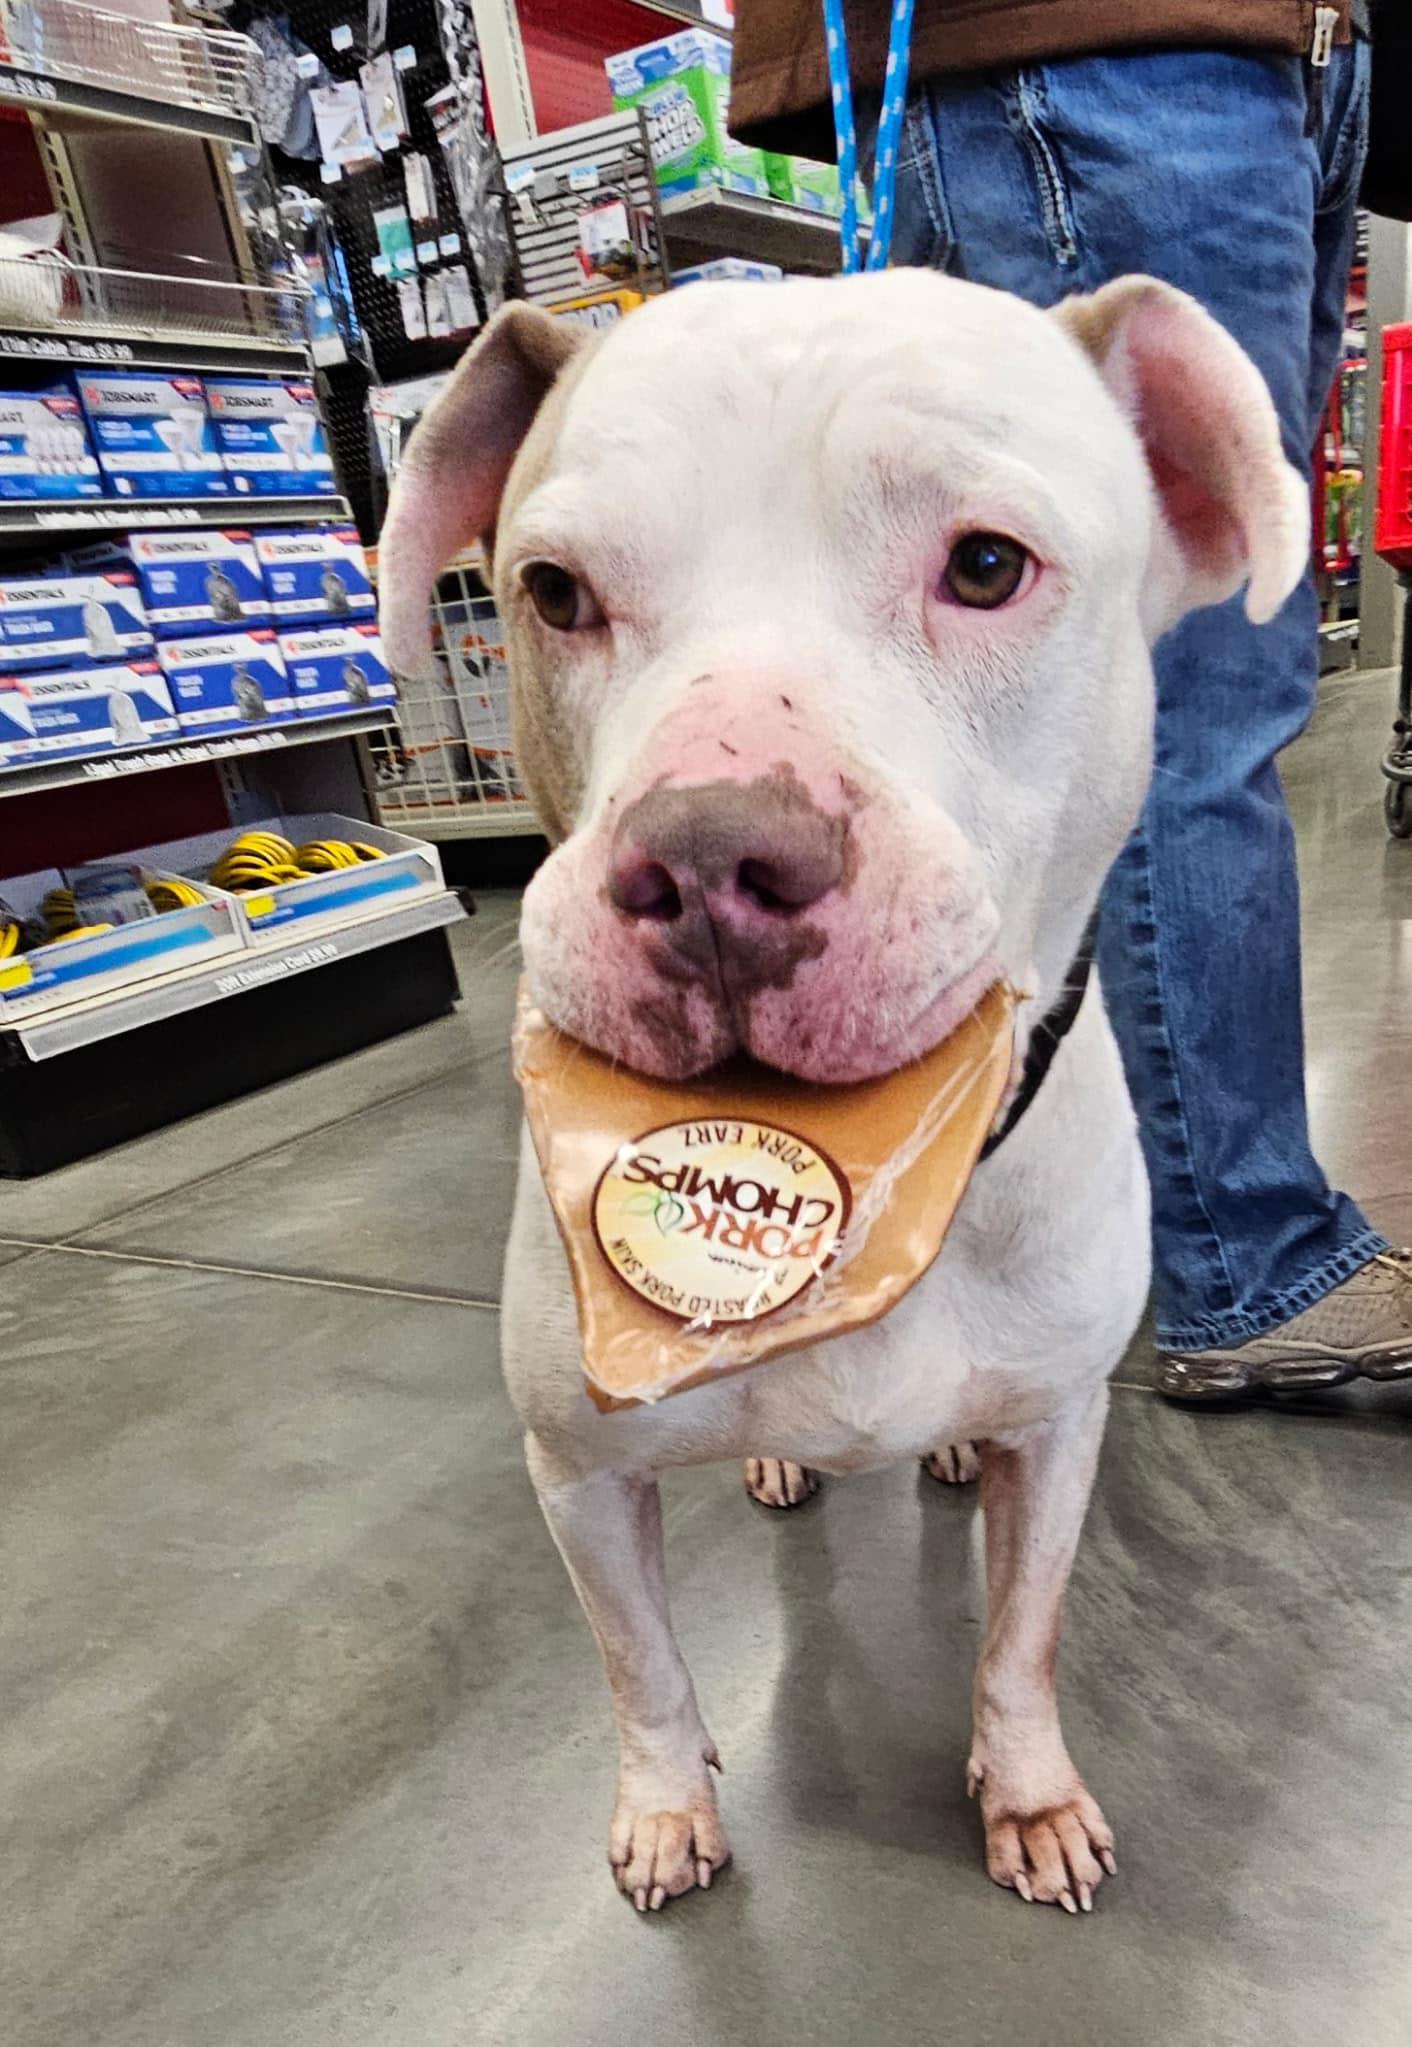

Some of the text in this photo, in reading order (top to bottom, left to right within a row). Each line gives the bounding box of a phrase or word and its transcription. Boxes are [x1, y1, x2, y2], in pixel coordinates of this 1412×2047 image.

[681, 1124, 816, 1174] PORK EARZ
[622, 1154, 835, 1228] CHOMPS
[681, 1202, 823, 1259] PORK
[609, 1238, 771, 1314] RASTED PORK SKIN
